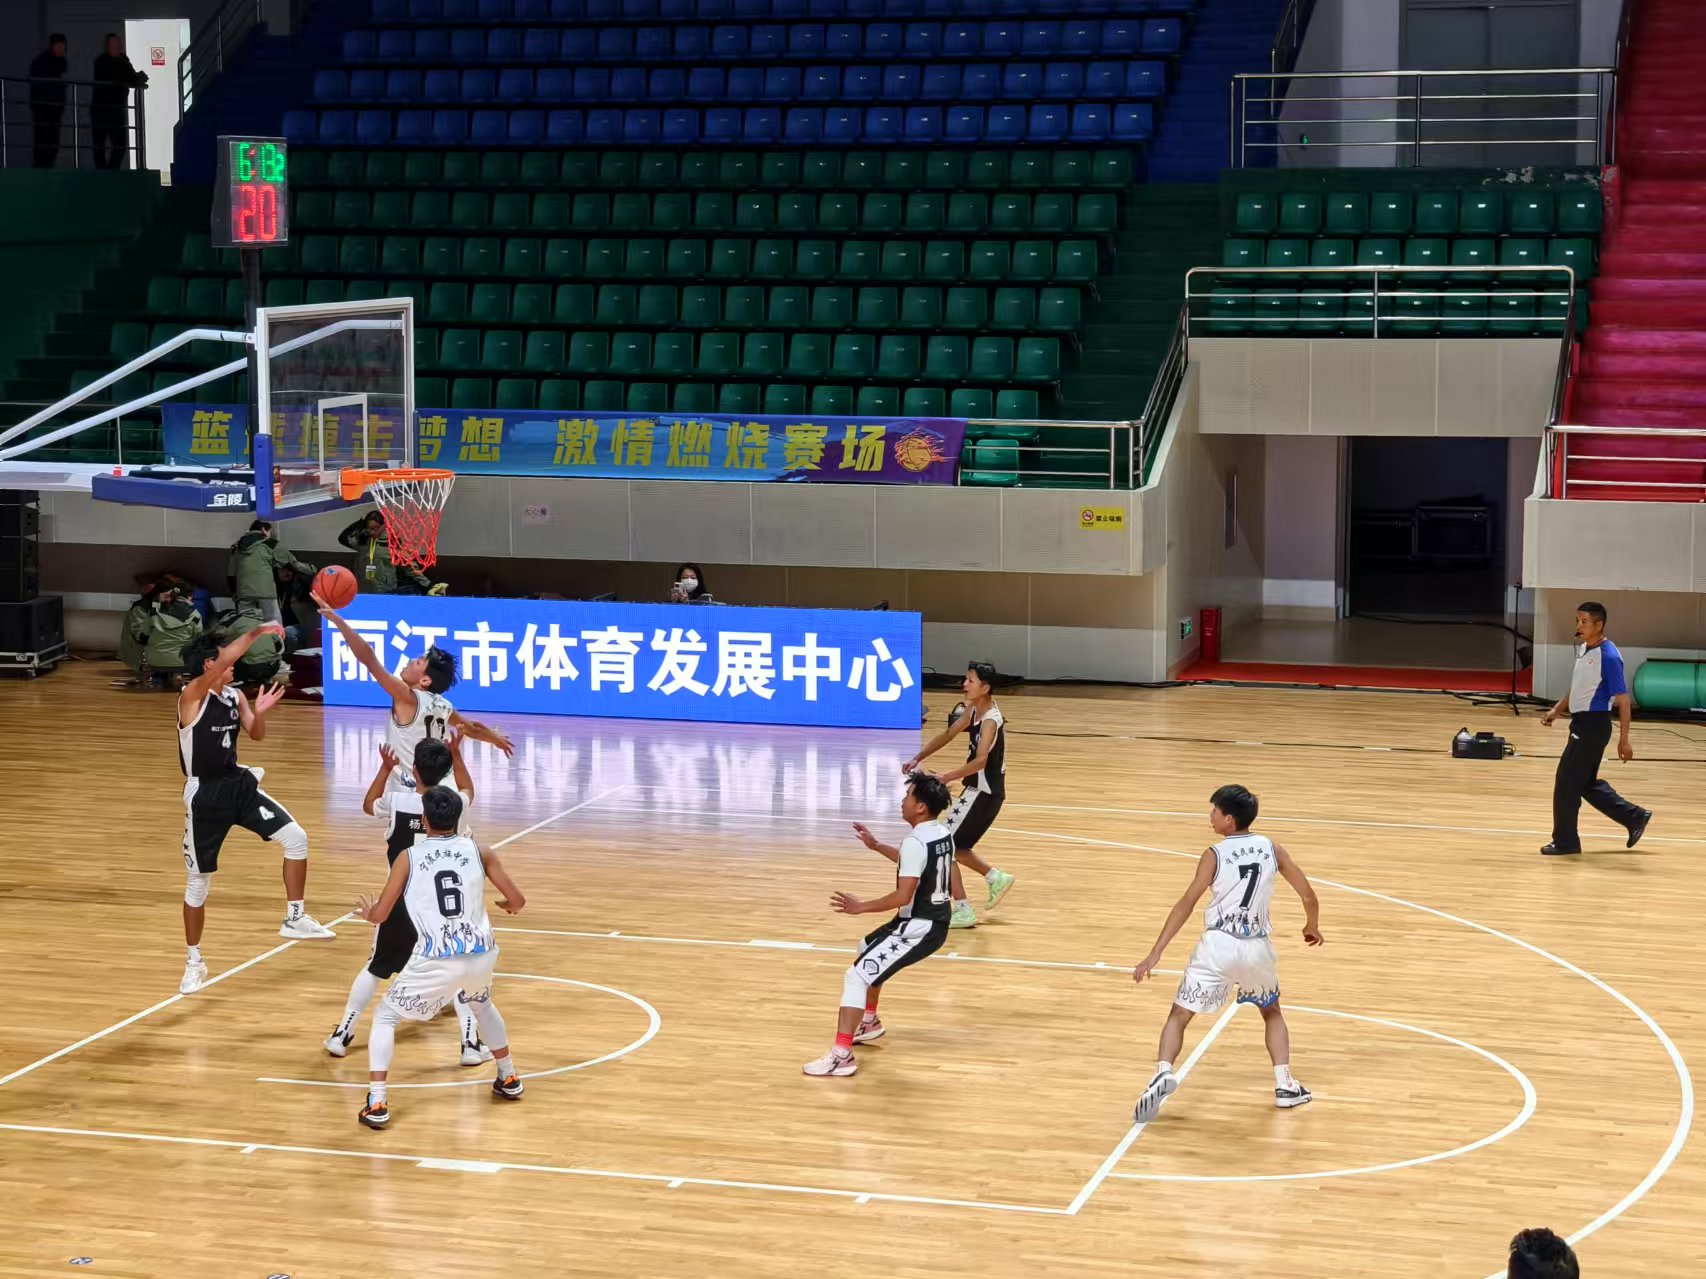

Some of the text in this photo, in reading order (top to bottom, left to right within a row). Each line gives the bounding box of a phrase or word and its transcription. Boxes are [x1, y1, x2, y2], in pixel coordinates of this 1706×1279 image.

[240, 185, 276, 241] 20
[553, 418, 886, 473] 激情燃烧赛场
[213, 493, 243, 506] 金陵
[328, 618, 915, 702] 丽江市体育发展中心
[221, 730, 232, 749] 4
[258, 805, 276, 821] 4
[434, 869, 465, 920] 6
[931, 854, 951, 905] 11
[1238, 862, 1263, 911] 7
